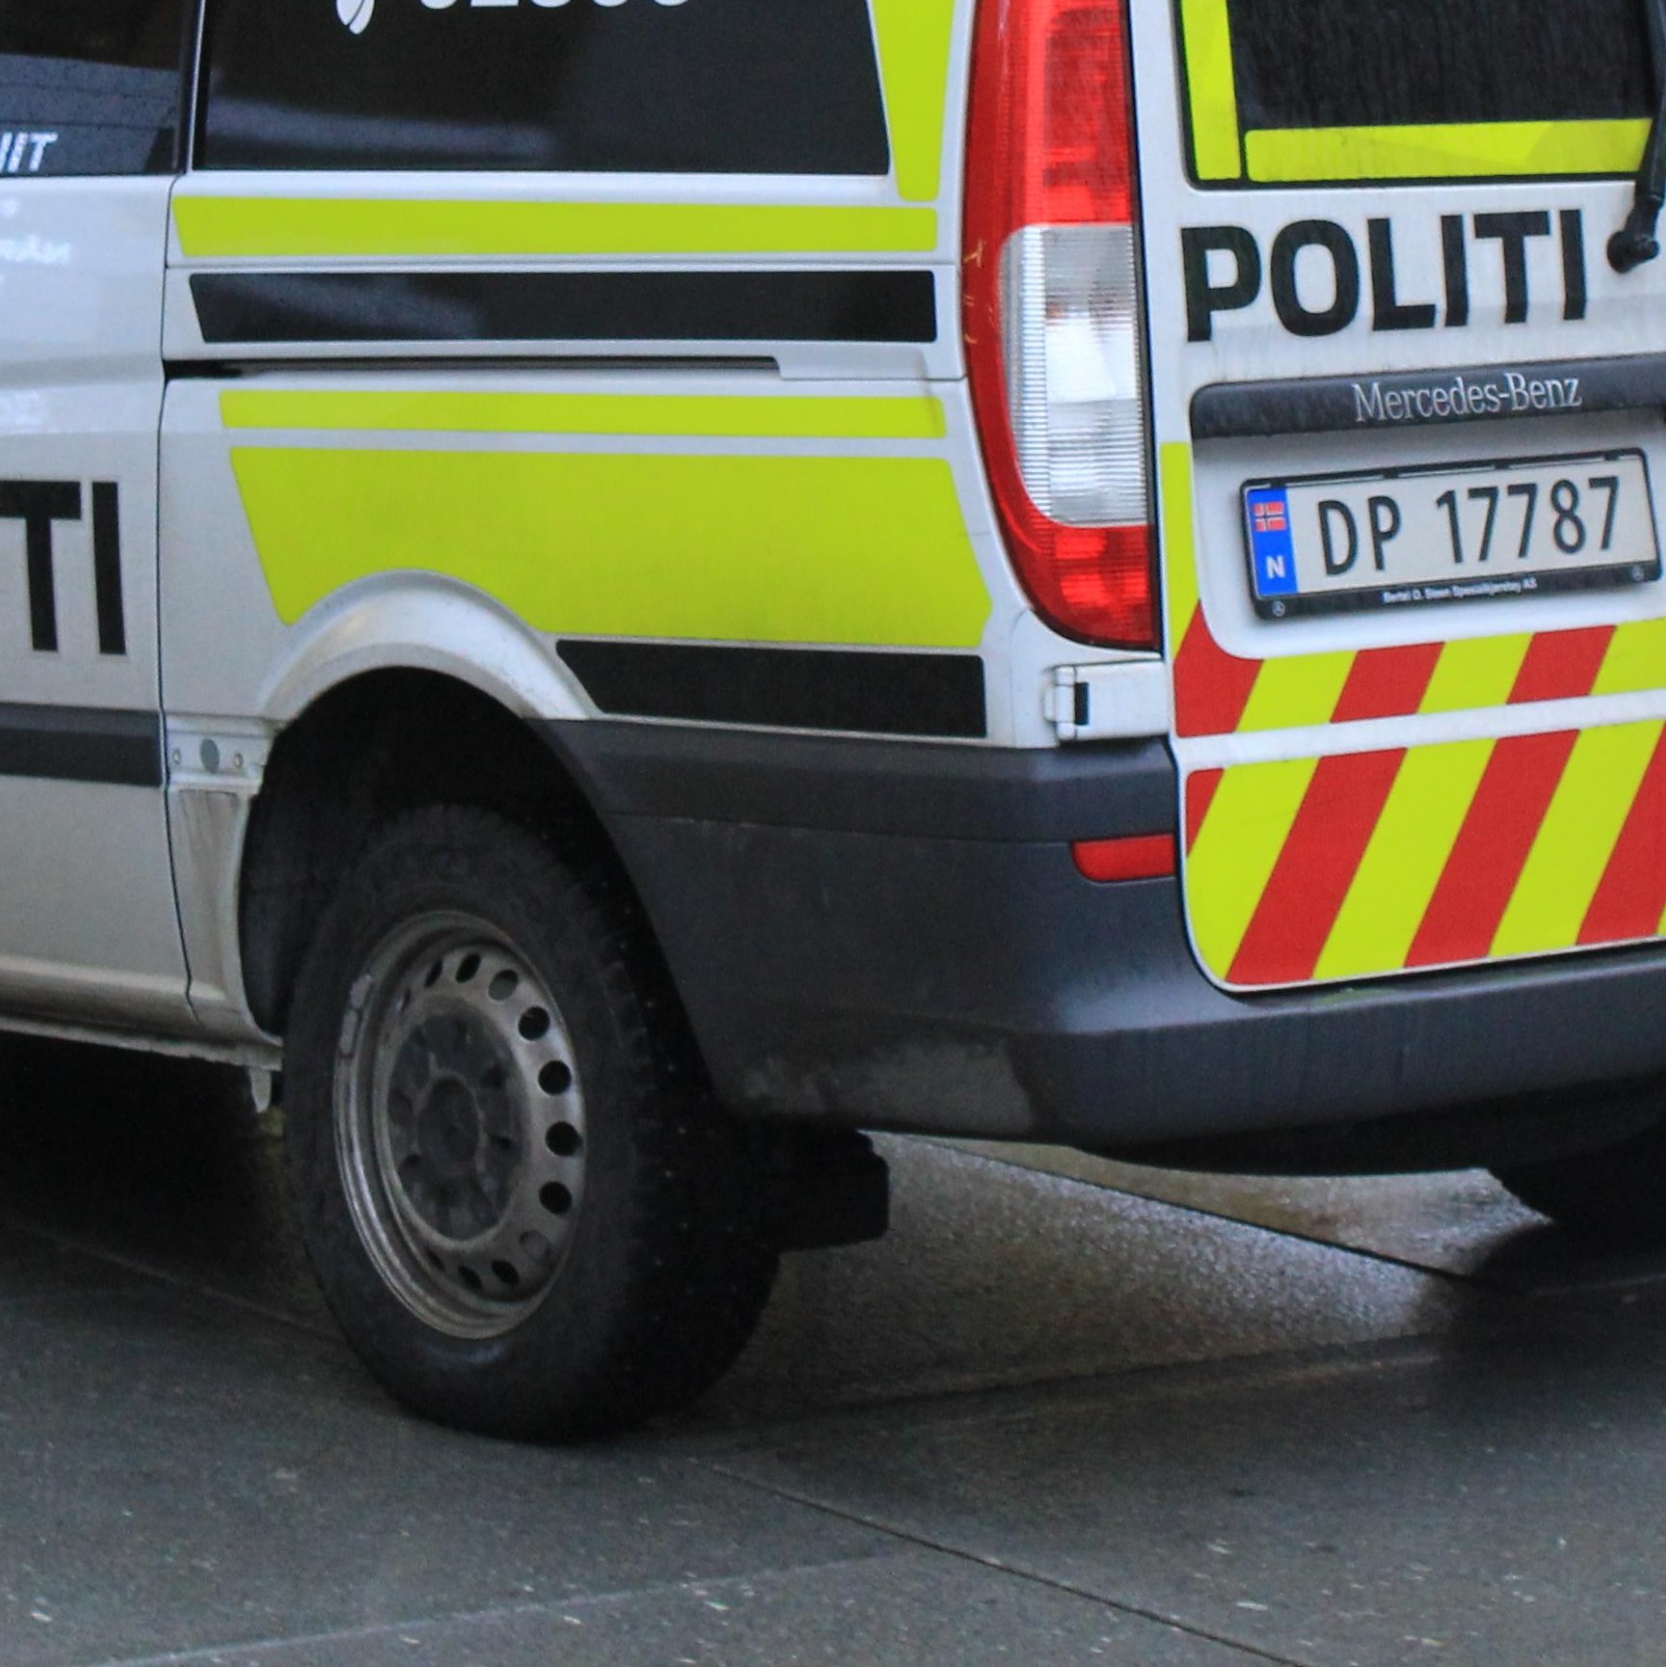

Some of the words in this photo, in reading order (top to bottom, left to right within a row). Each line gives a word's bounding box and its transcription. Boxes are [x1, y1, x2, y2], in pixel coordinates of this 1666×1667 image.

[1180, 209, 1586, 342] POLITI
[1352, 371, 1583, 423] Mercedes-Benz
[1317, 495, 1402, 577] DP
[1436, 476, 1620, 564] 17787
[1266, 555, 1286, 579] N
